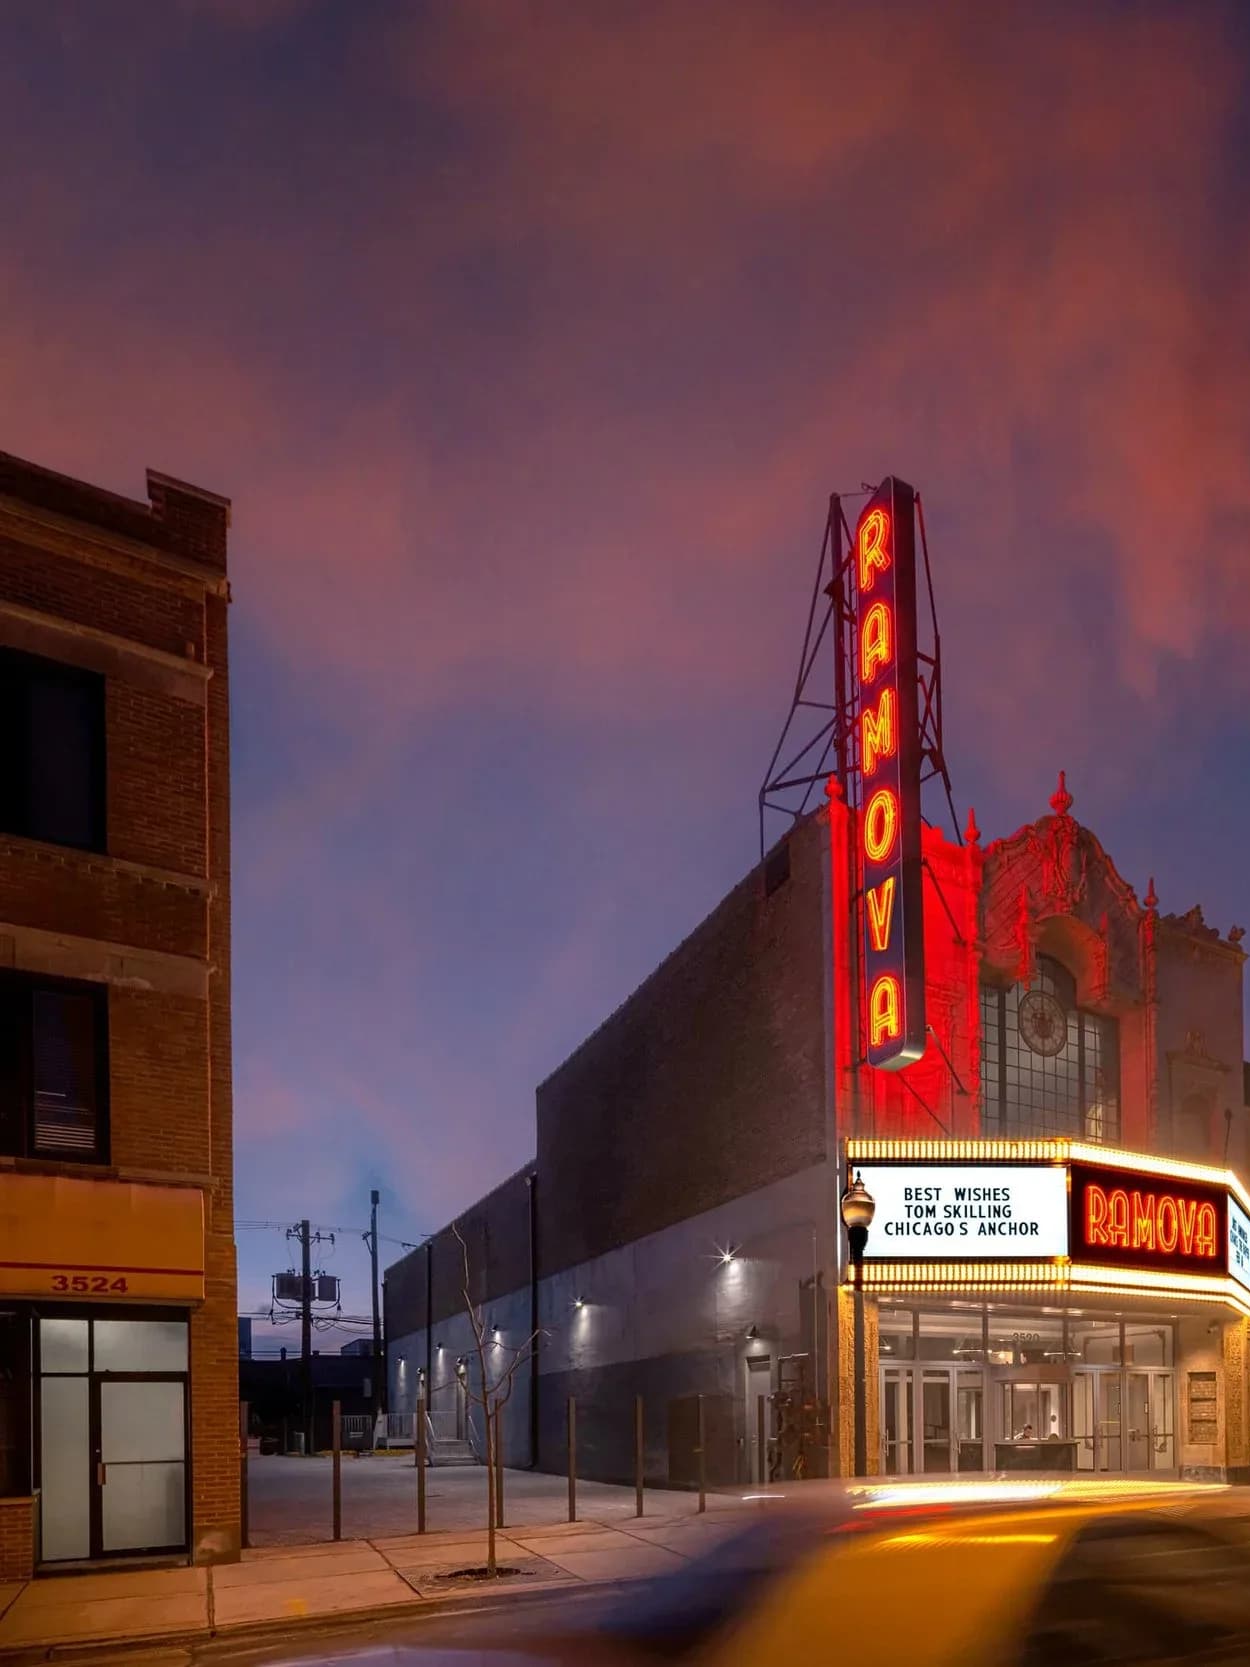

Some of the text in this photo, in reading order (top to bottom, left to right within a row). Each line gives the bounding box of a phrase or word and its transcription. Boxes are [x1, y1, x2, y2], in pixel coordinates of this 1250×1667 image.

[860, 508, 902, 1048] RAMOVA
[904, 1187, 1011, 1201] BEST WISHES
[904, 1204, 1013, 1219] TOM SKILLING
[977, 1221, 1040, 1236] ANCHOR
[1086, 1184, 1217, 1257] RAMOVA
[51, 1274, 129, 1293] 3524
